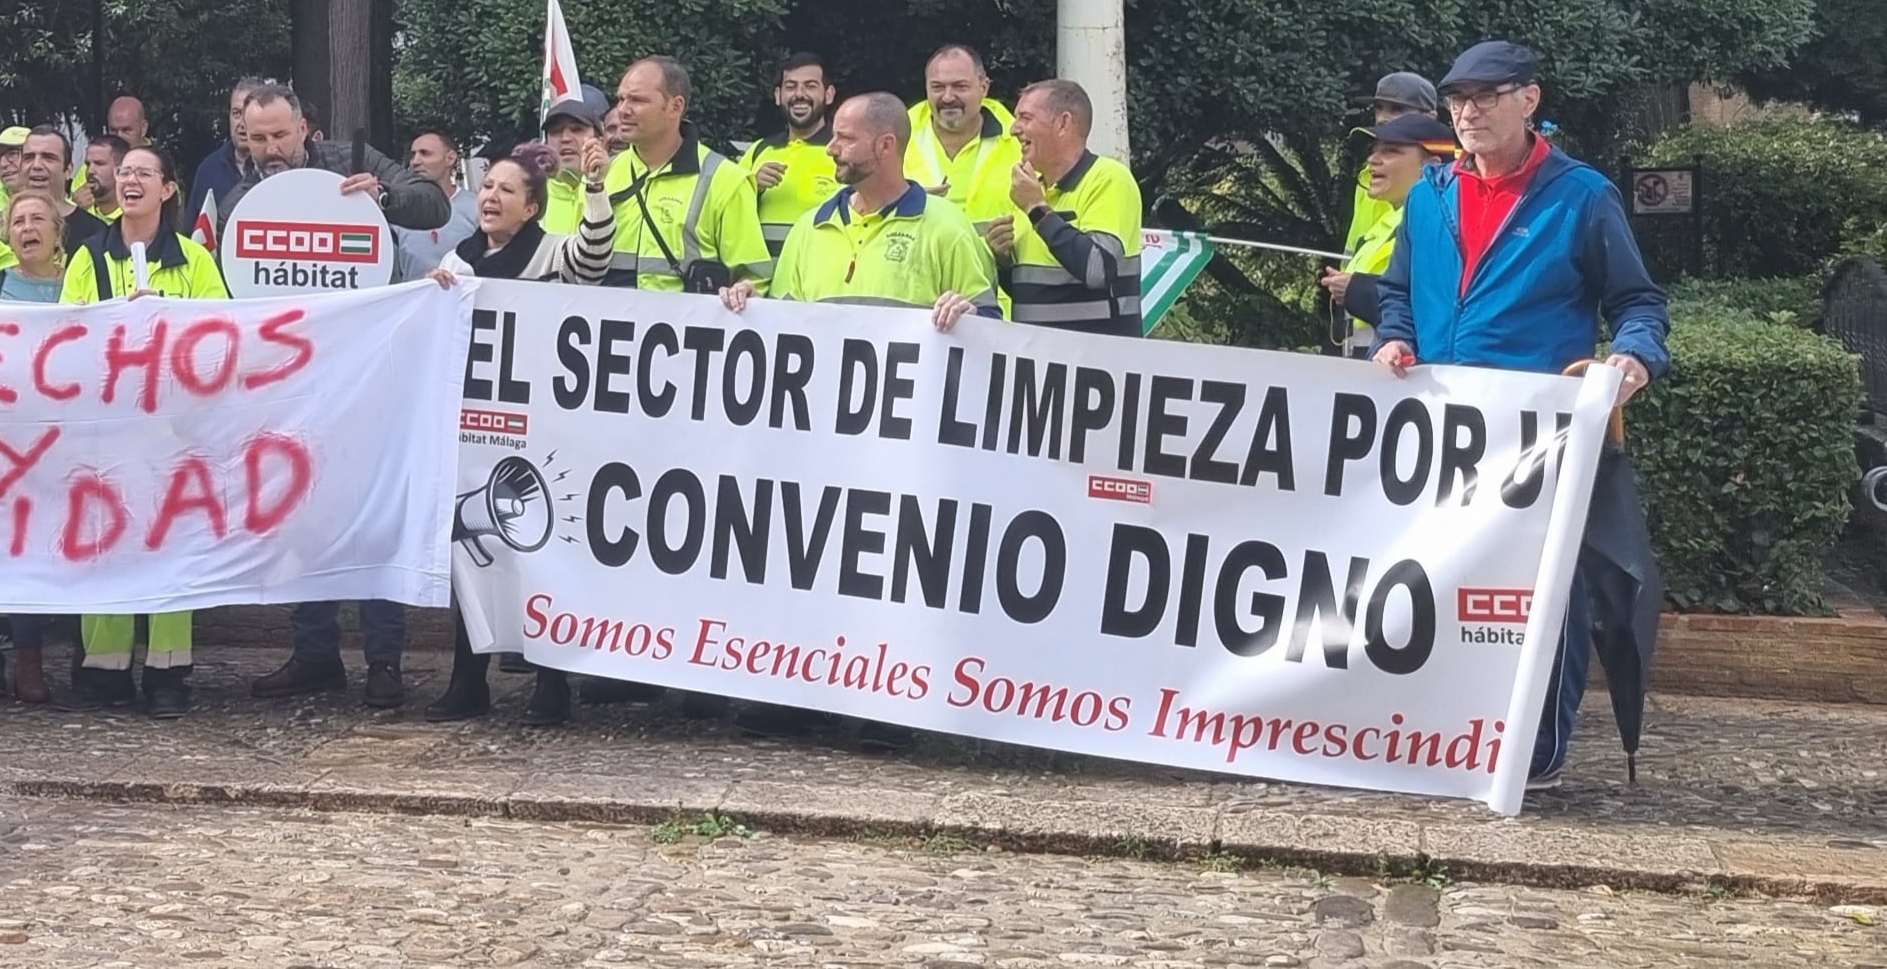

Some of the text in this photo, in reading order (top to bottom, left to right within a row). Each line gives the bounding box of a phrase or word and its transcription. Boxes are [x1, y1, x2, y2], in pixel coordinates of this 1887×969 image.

[243, 229, 334, 254] CCOO
[254, 261, 358, 289] hábitat
[463, 309, 531, 404] EL
[552, 316, 814, 431] SECTOR
[835, 339, 921, 440] DE
[938, 346, 1295, 491] LIMPIEZA
[1324, 393, 1487, 507] POR
[489, 435, 527, 450] Málaga
[1092, 480, 1138, 494] CCOO
[586, 461, 1436, 675] CONVENIO DIGNO
[523, 593, 1505, 775] Somos Esenciales Somos Imprescindi
